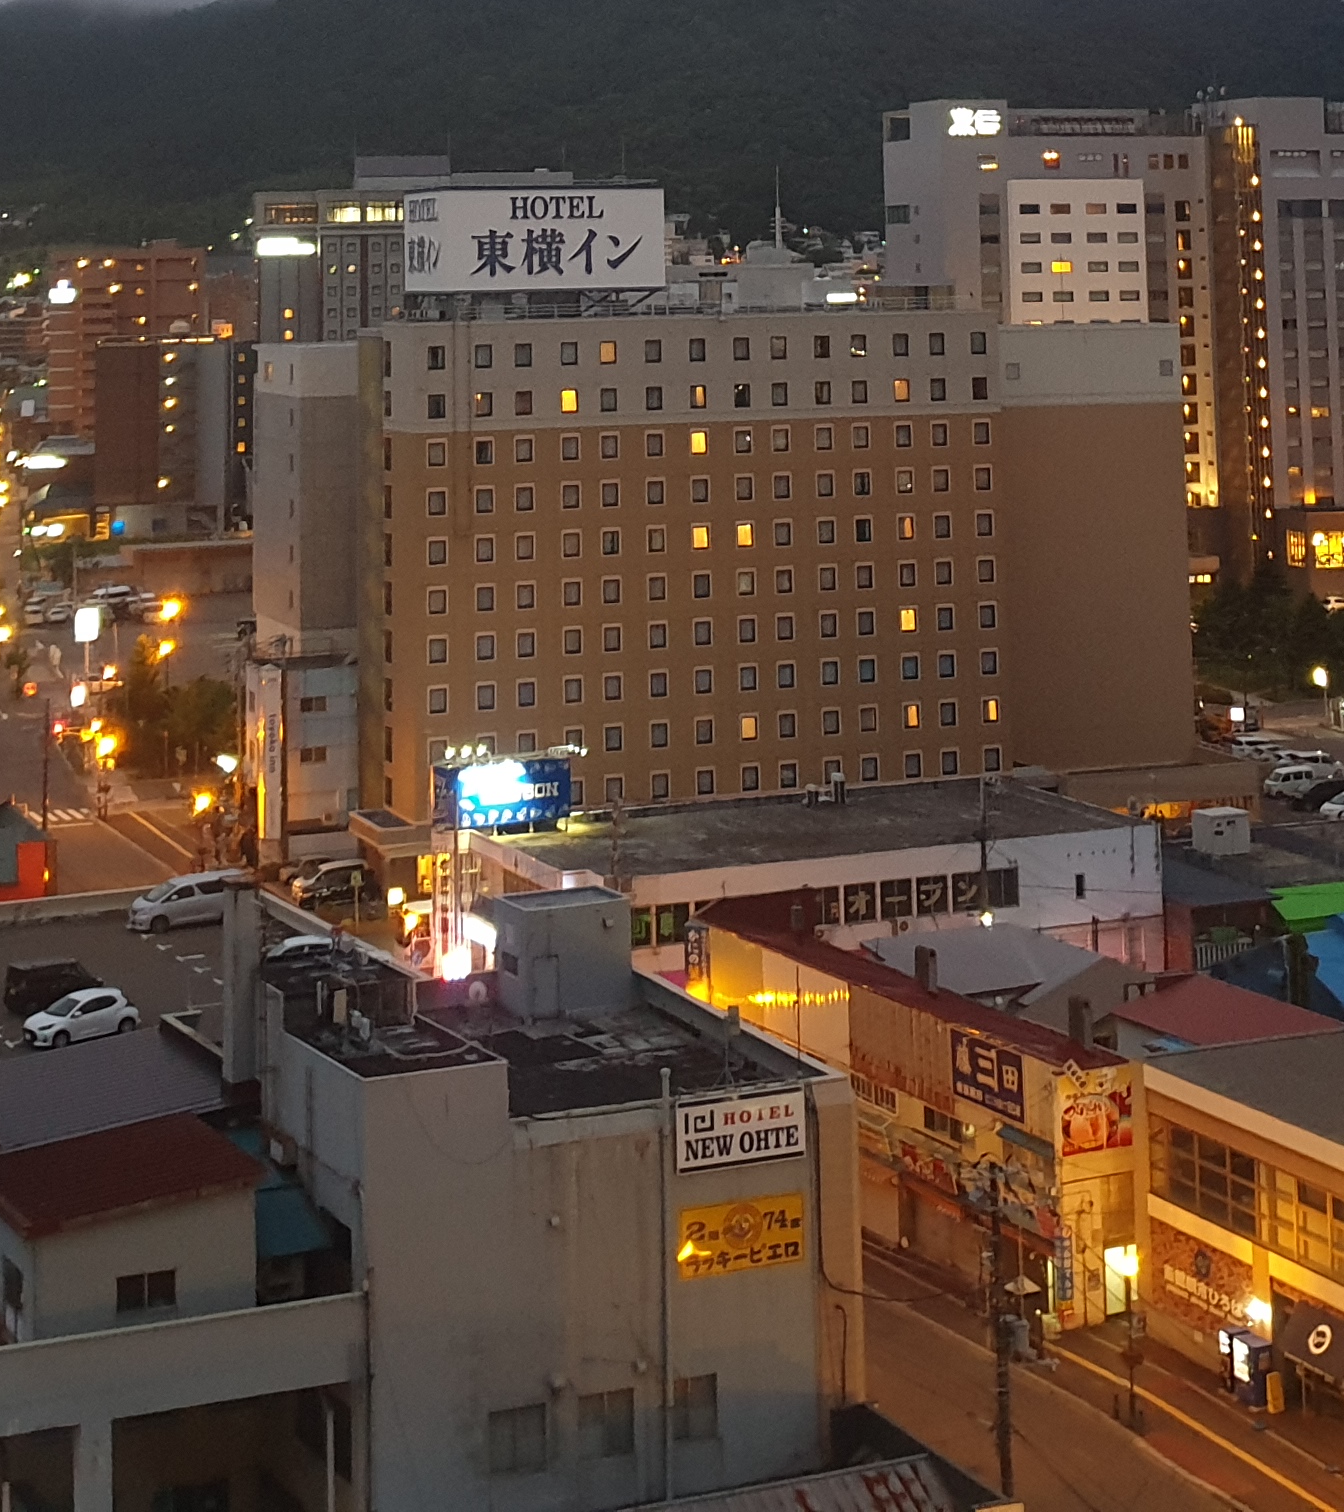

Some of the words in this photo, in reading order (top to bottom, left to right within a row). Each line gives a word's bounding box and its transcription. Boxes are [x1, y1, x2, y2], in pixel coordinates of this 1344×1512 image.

[509, 195, 605, 220] HOTEL
[470, 227, 644, 278] 東横イン
[848, 880, 978, 917] オープン
[723, 1104, 795, 1126] HOTEL
[684, 1133, 734, 1162] NEW
[739, 1124, 800, 1155] OHTE
